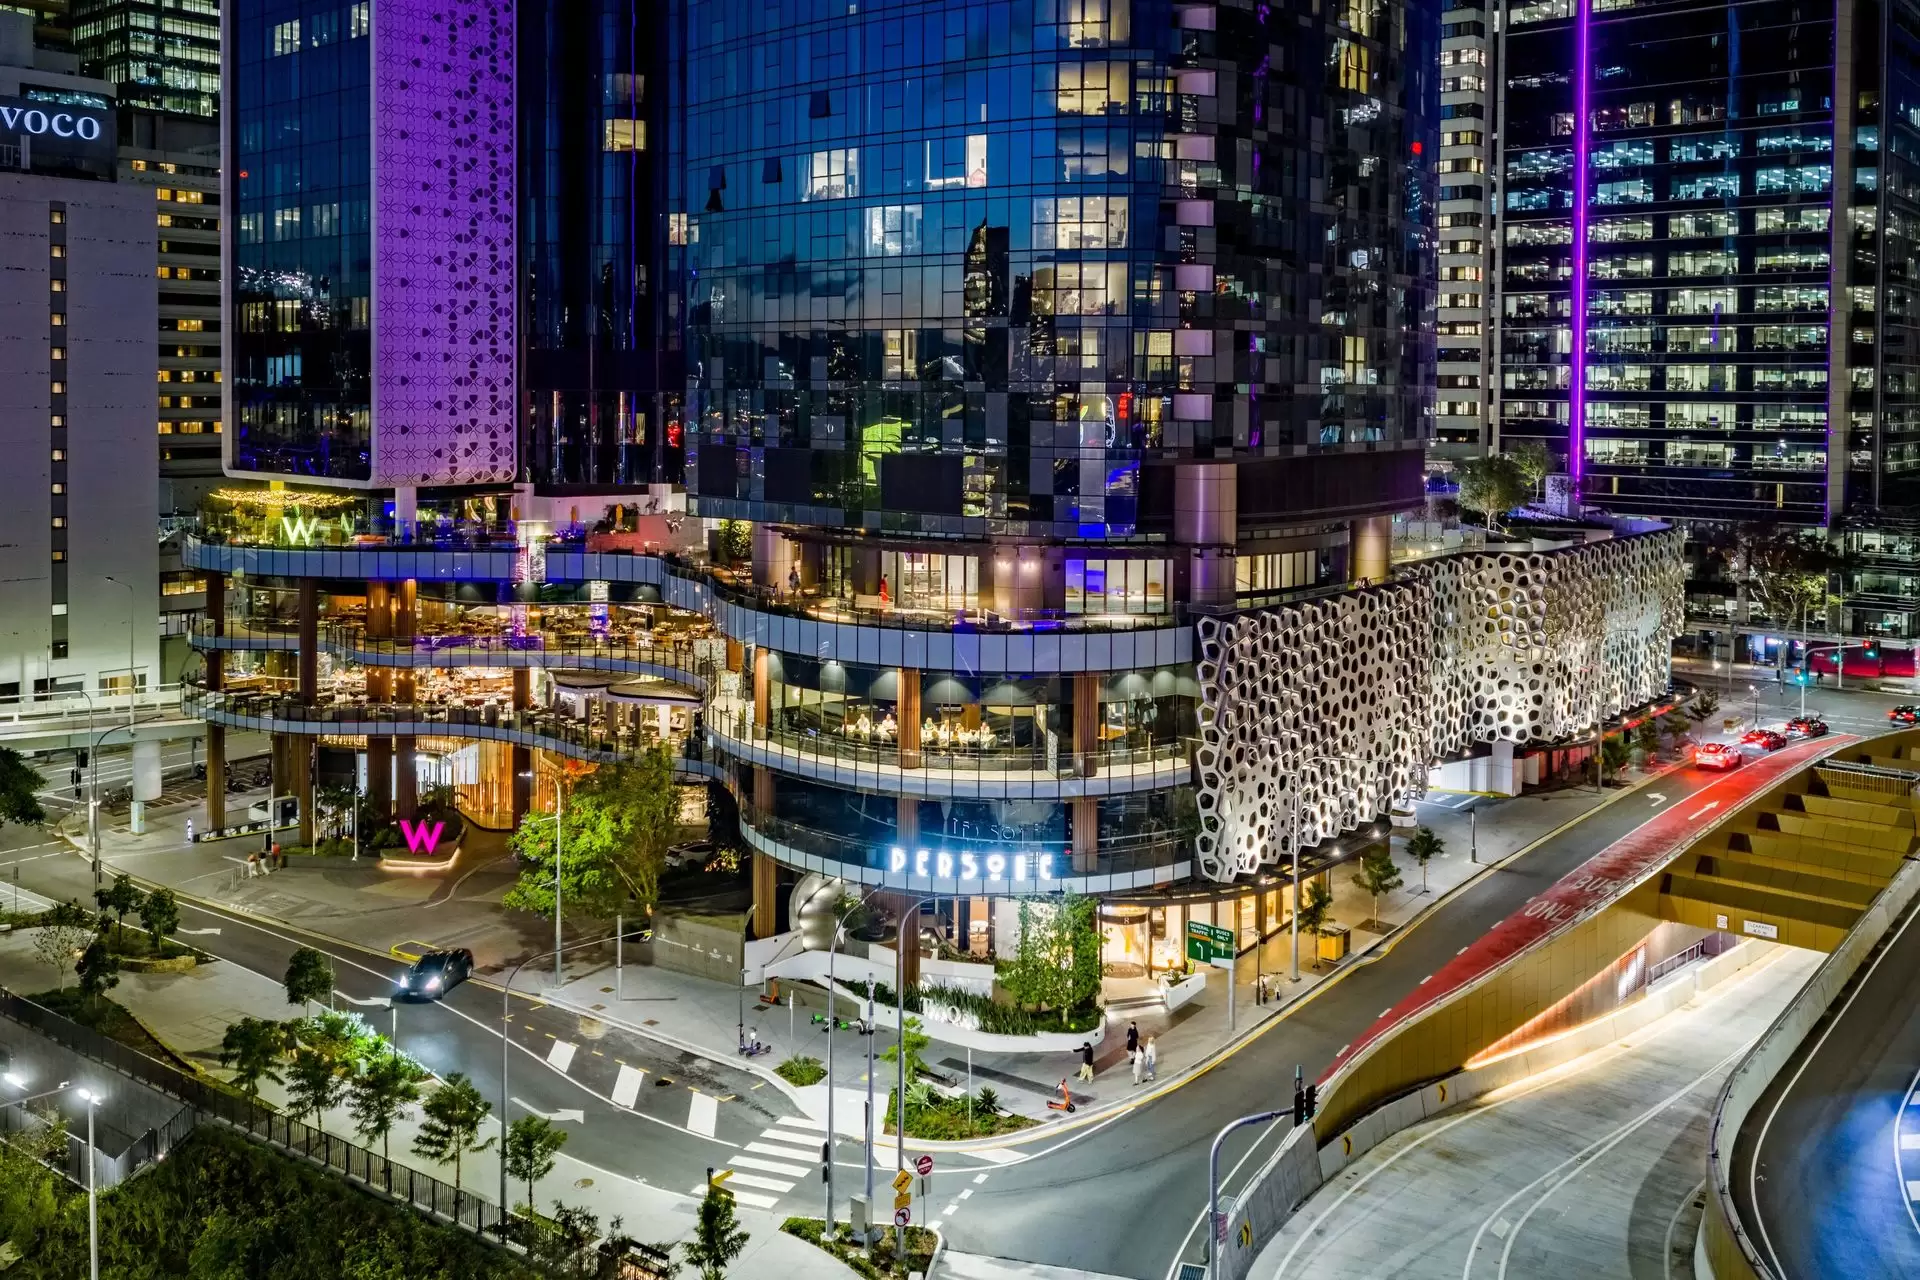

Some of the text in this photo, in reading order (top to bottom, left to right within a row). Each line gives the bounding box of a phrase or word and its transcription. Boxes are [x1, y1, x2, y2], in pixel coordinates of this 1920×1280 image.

[281, 516, 319, 545] W
[399, 819, 447, 856] W
[1569, 875, 1622, 894] BUS
[1524, 901, 1576, 921] ONL
[1190, 923, 1209, 931] GENERAL
